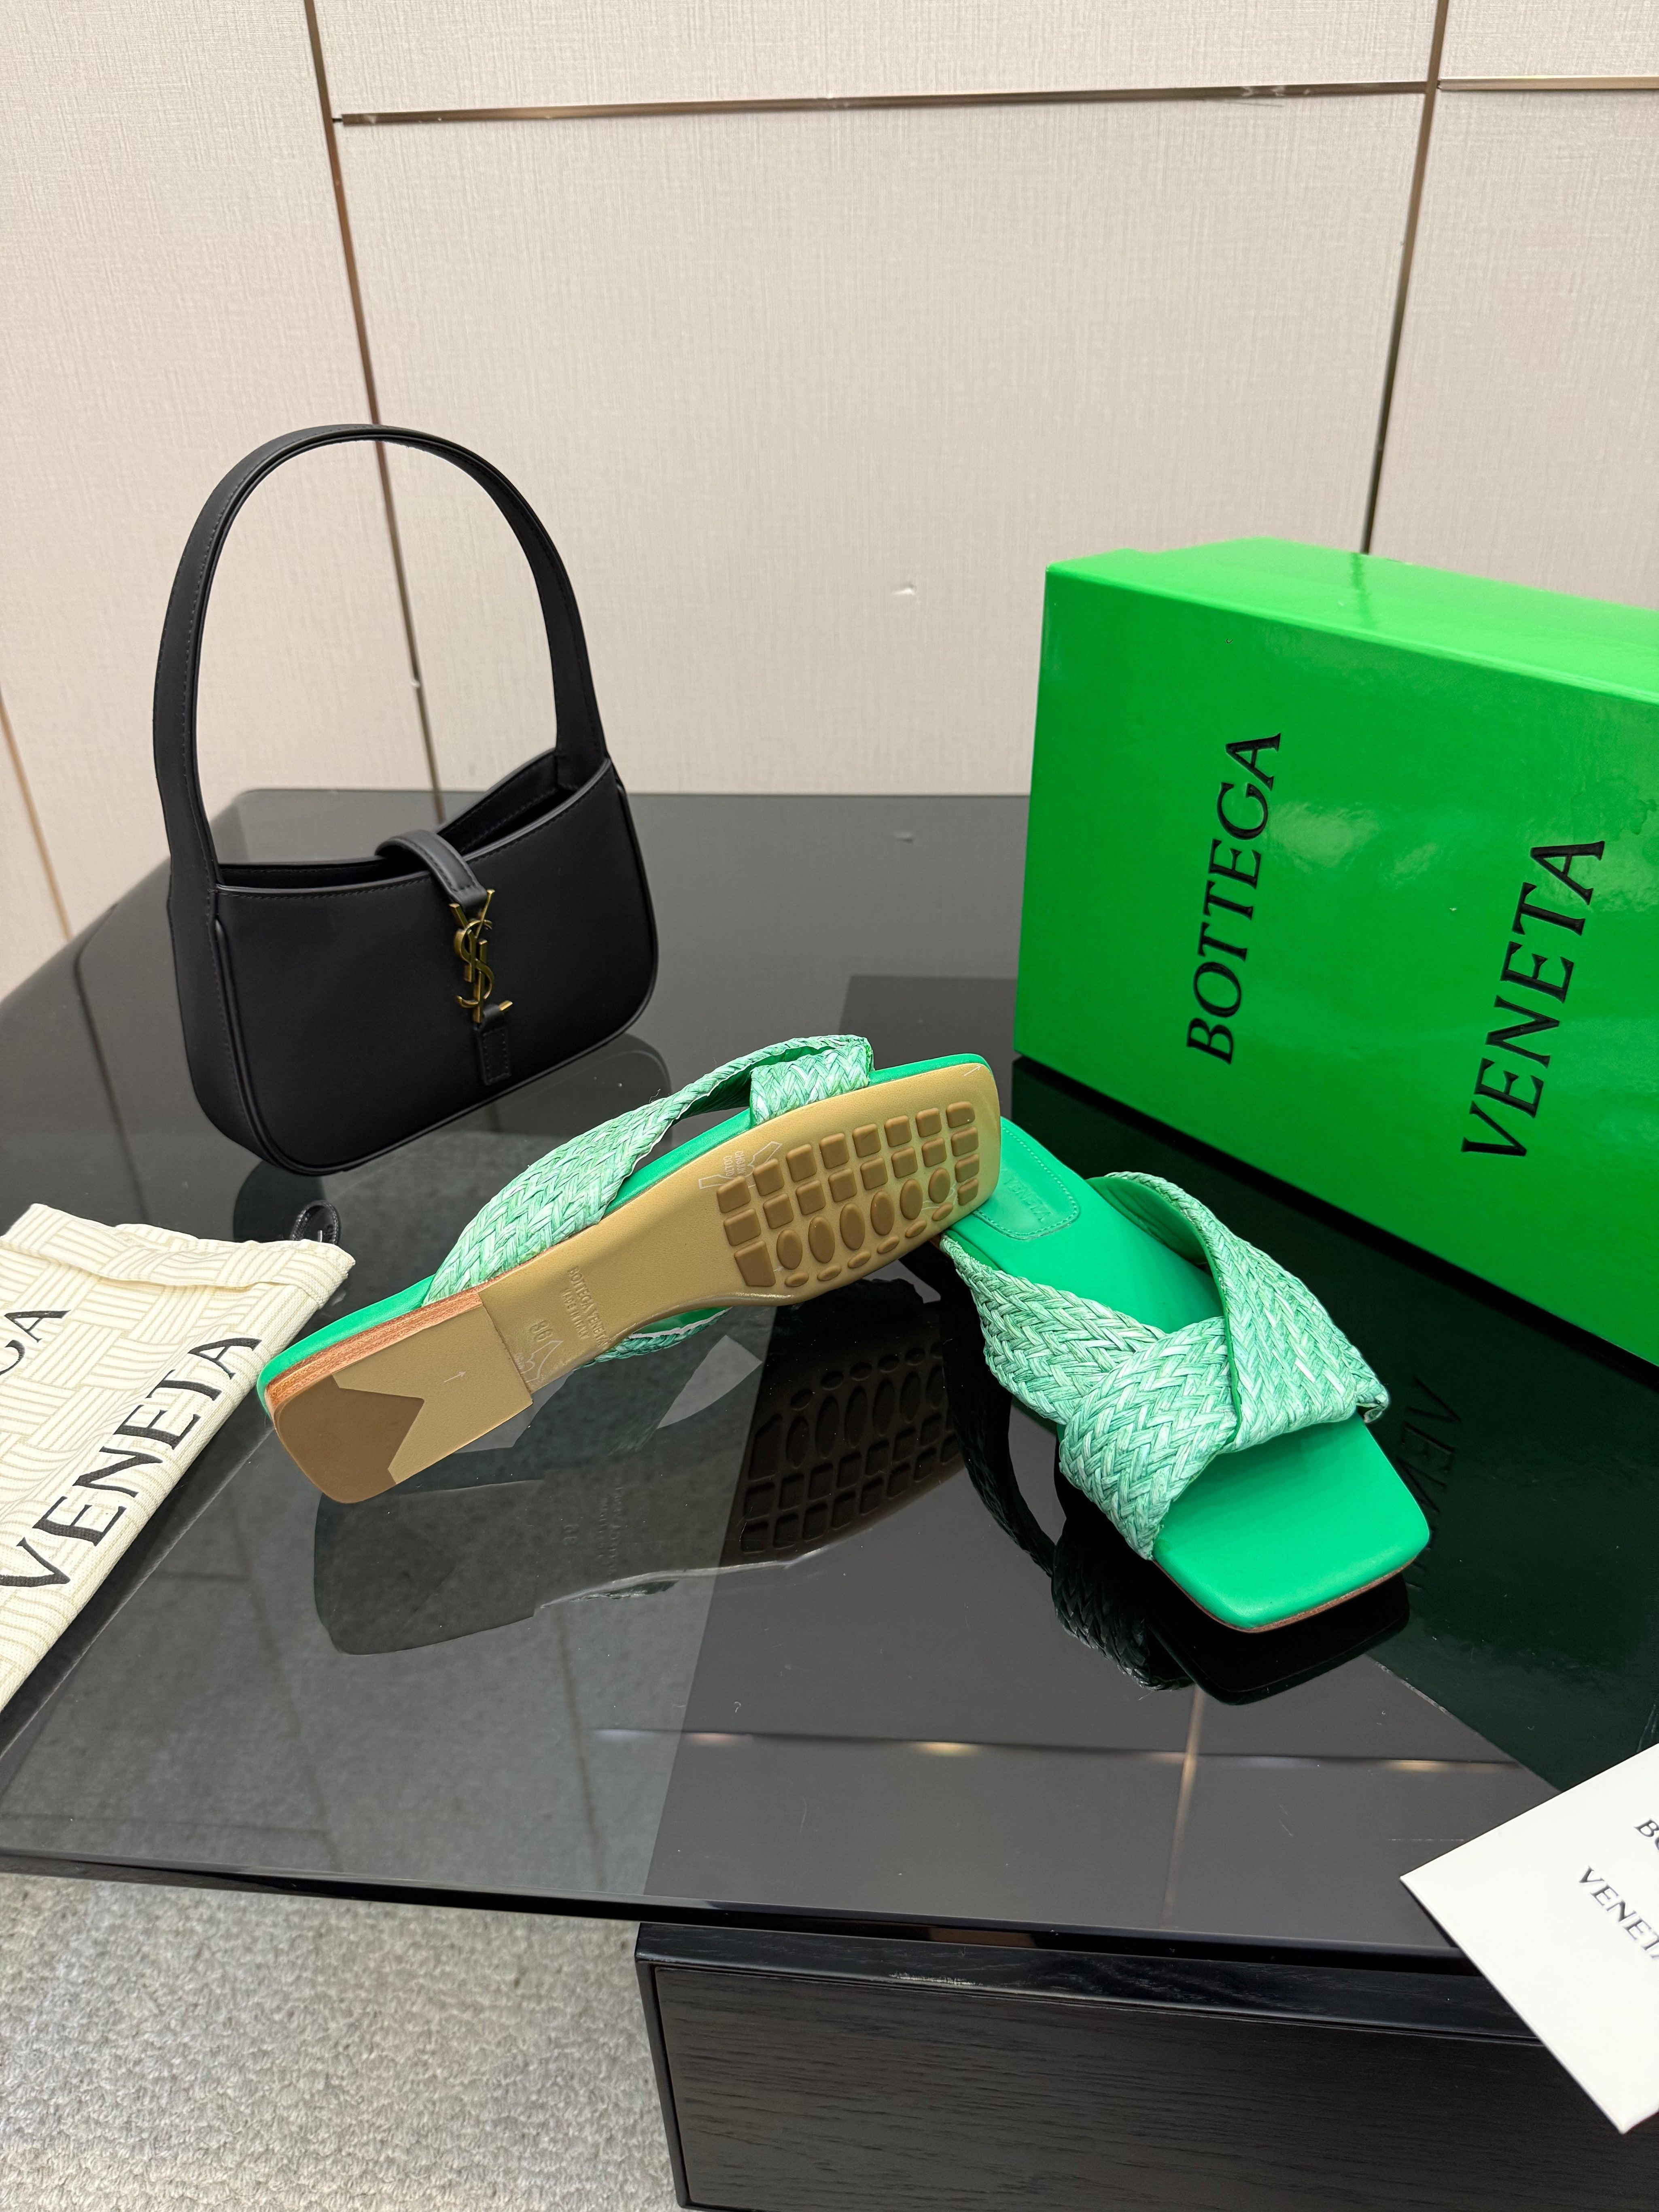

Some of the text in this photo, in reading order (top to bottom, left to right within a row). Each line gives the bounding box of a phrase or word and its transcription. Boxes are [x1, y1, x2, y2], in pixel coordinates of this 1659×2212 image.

[1186, 732, 1282, 1066] BOTTEGA
[1460, 840, 1606, 1157] VENETA
[567, 1265, 597, 1314] BOTTEGA
[0, 1337, 261, 1588] VENETA
[1578, 1865, 1659, 1960] VENET
[1633, 1818, 1659, 1851] B
